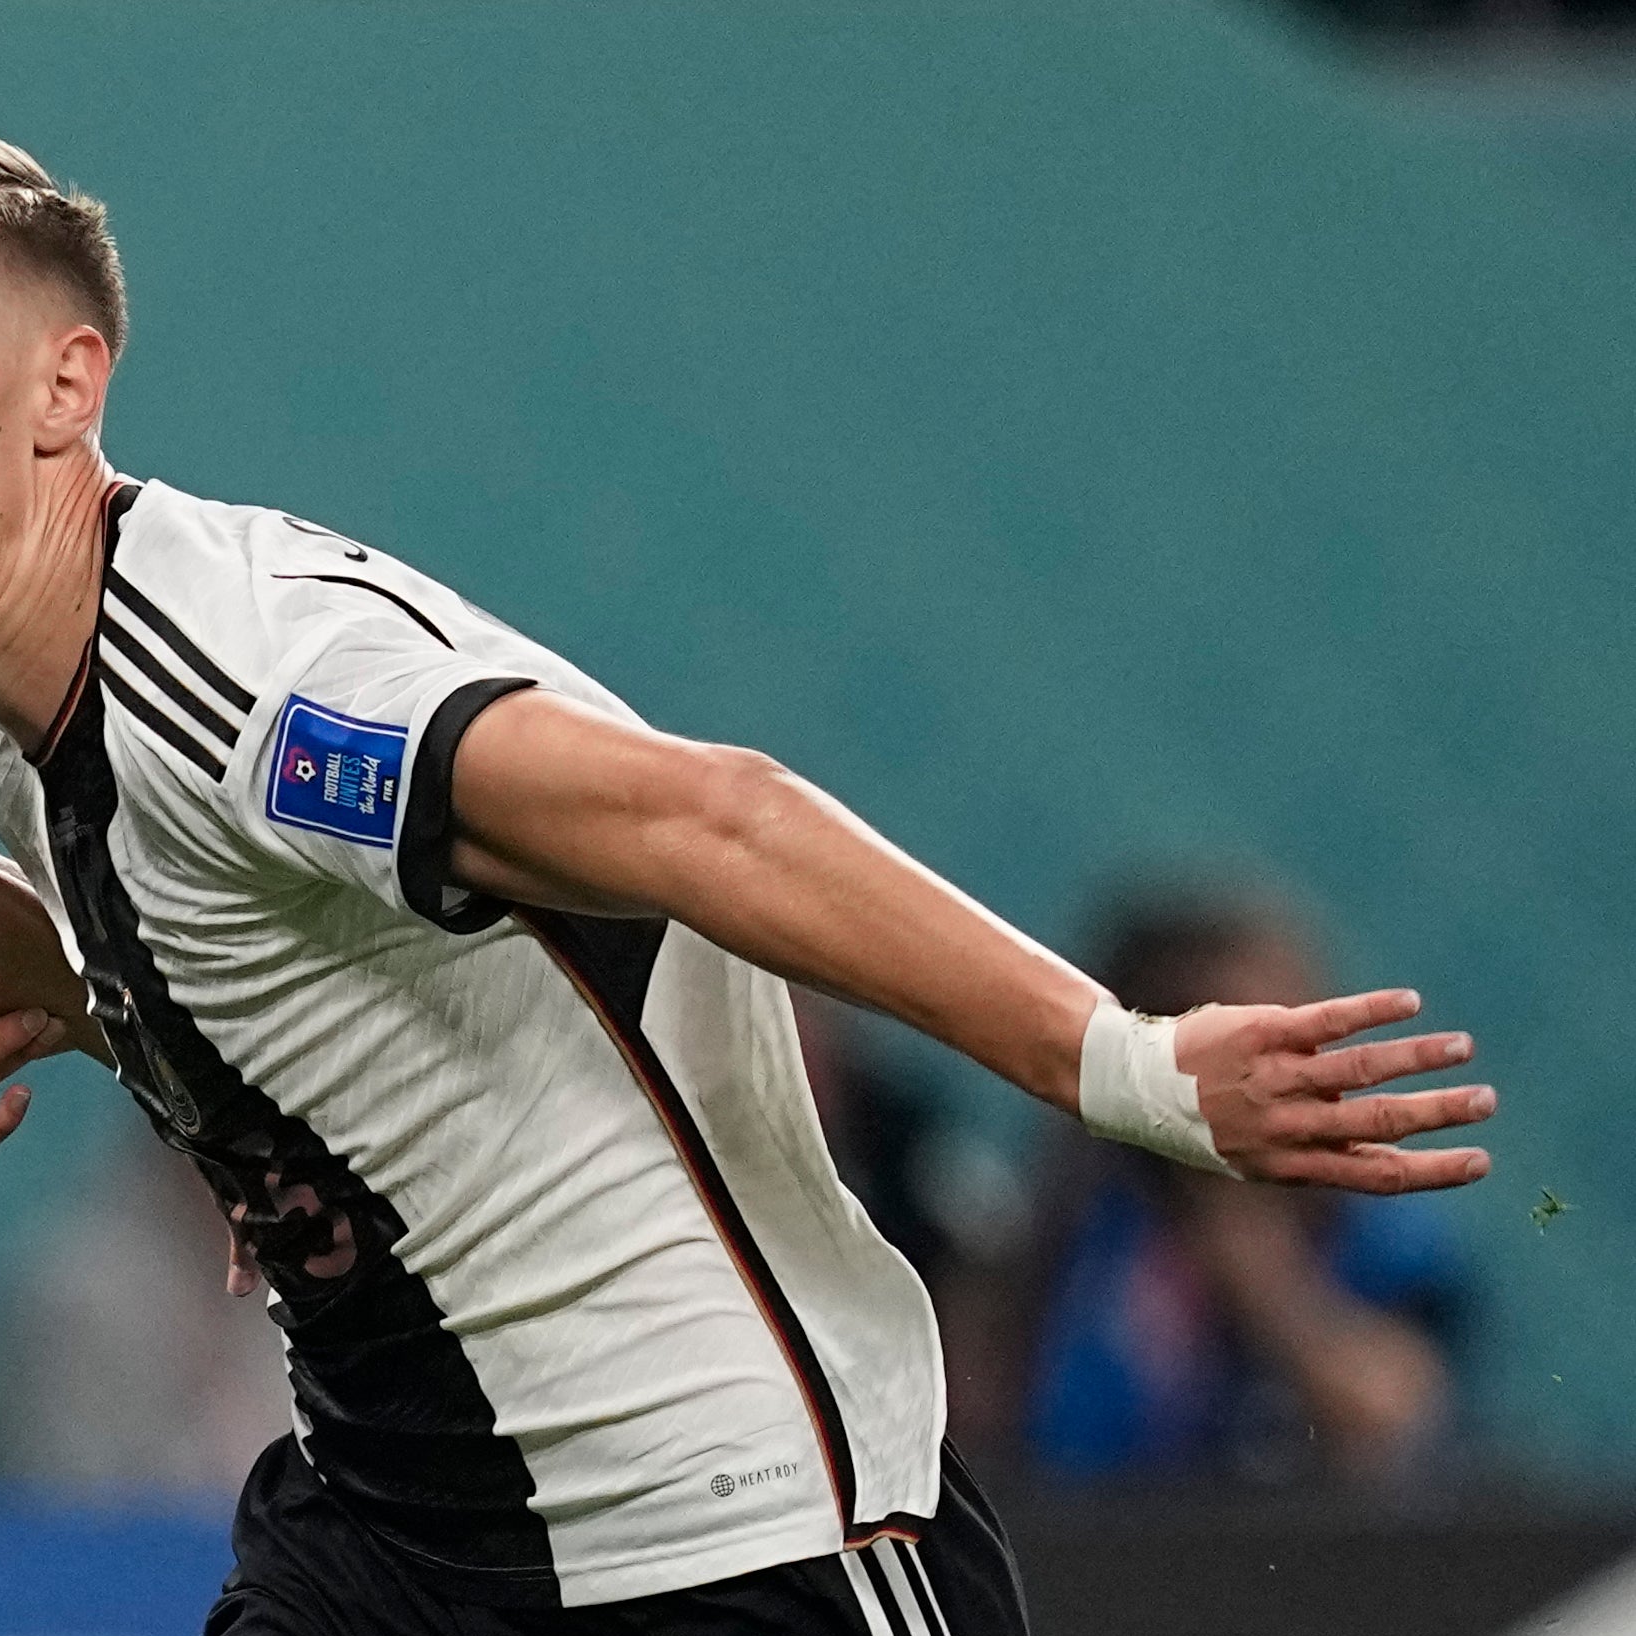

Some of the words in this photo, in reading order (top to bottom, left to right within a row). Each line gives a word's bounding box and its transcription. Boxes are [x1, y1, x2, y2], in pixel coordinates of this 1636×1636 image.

[324, 752, 342, 804] FOOTBALL
[338, 754, 362, 808] UNITES
[359, 753, 382, 796] World
[382, 779, 395, 802] FIFA
[357, 795, 376, 815] the
